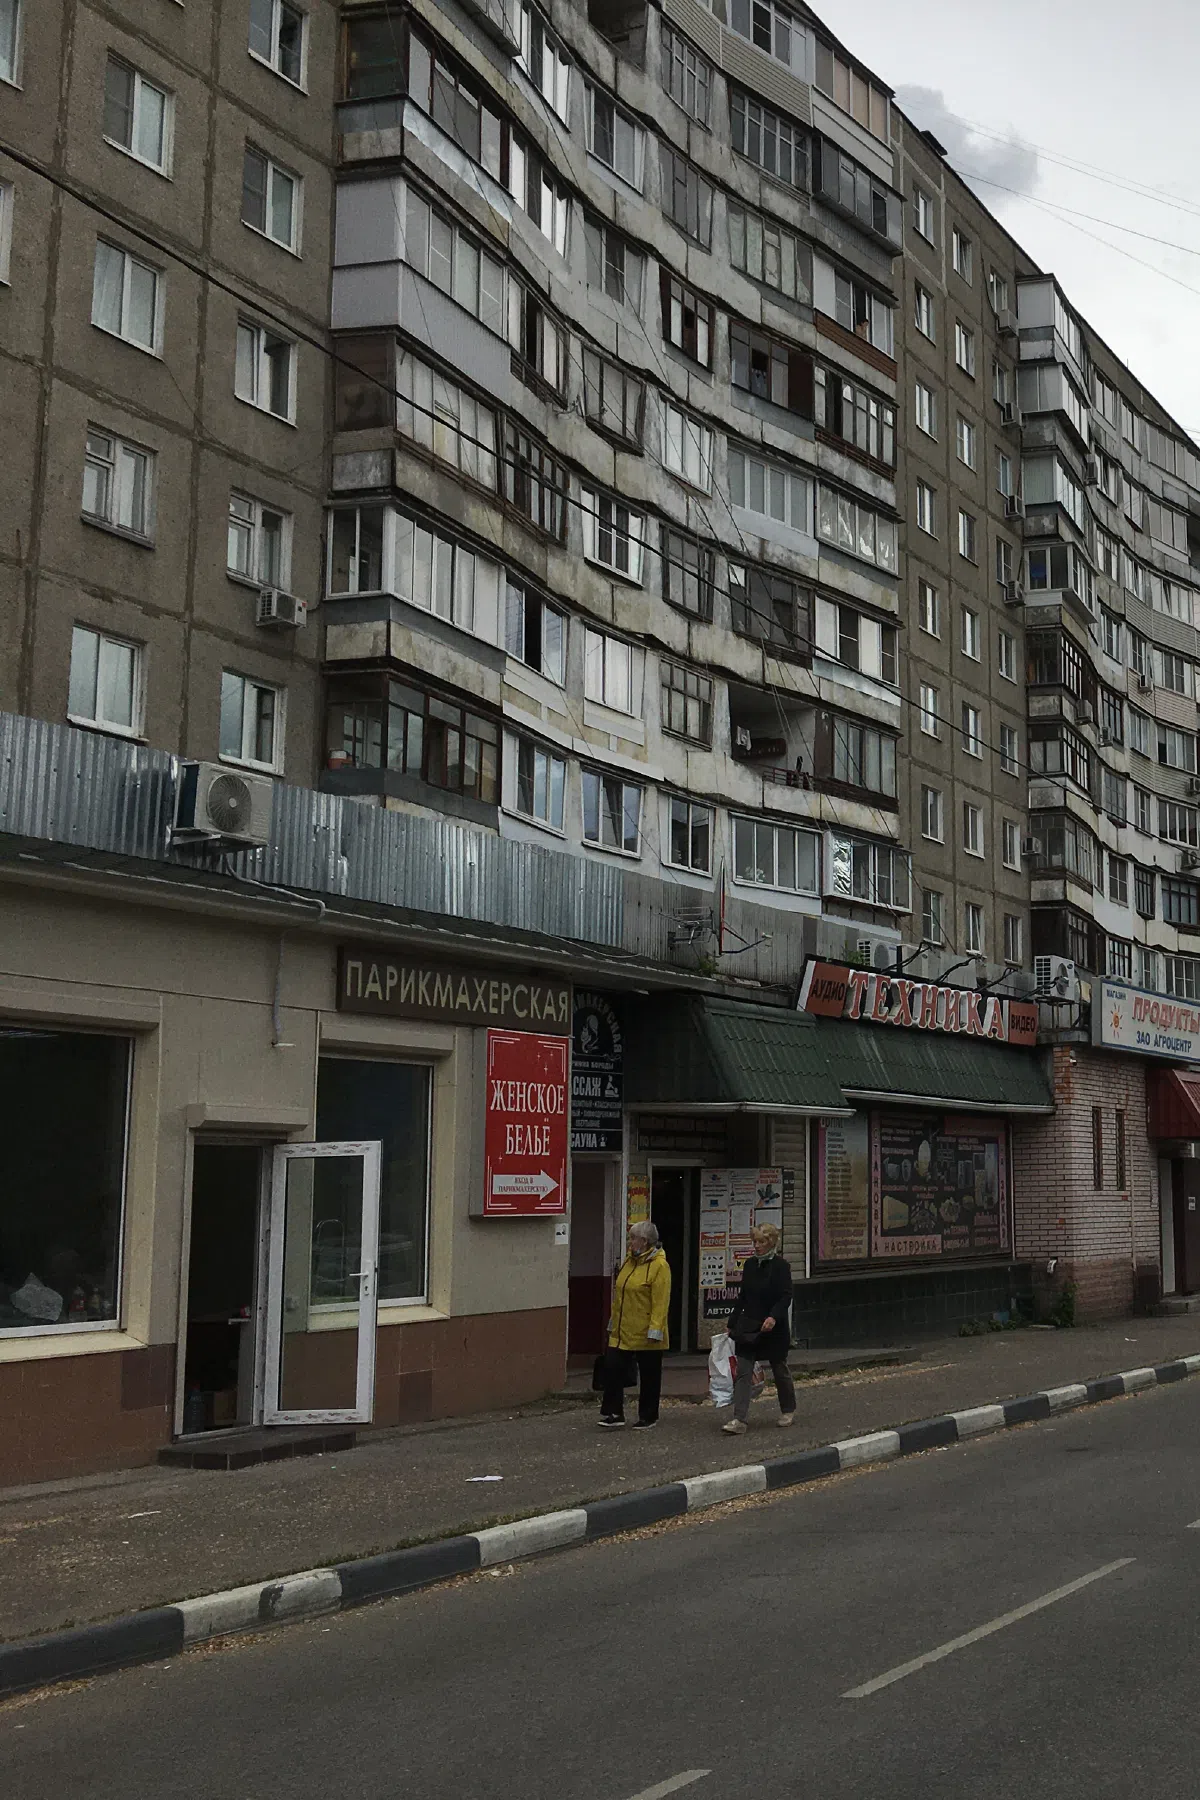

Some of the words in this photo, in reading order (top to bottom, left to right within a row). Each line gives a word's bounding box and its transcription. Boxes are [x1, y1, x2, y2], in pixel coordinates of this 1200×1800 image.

[346, 960, 568, 1023] ПАРИКМАХЕРСКАЯ
[811, 978, 845, 1002] АУДИО
[849, 969, 1005, 1041] ТЕХНИКА
[1132, 996, 1200, 1034] ПРОДУКТЫ
[1010, 1013, 1036, 1033] ВИДЕО
[1136, 1030, 1151, 1046] ЗАО
[1153, 1034, 1192, 1053] АГРОЦЕНТР
[490, 1079, 565, 1115] ЖЕНСКОЕ
[573, 1075, 602, 1097] ССАЖ
[505, 1118, 551, 1156] БЕЛЬЁ
[498, 1185, 549, 1193] ПАРИКМАХЕРСКУЮ
[514, 1177, 529, 1185] ВХОД
